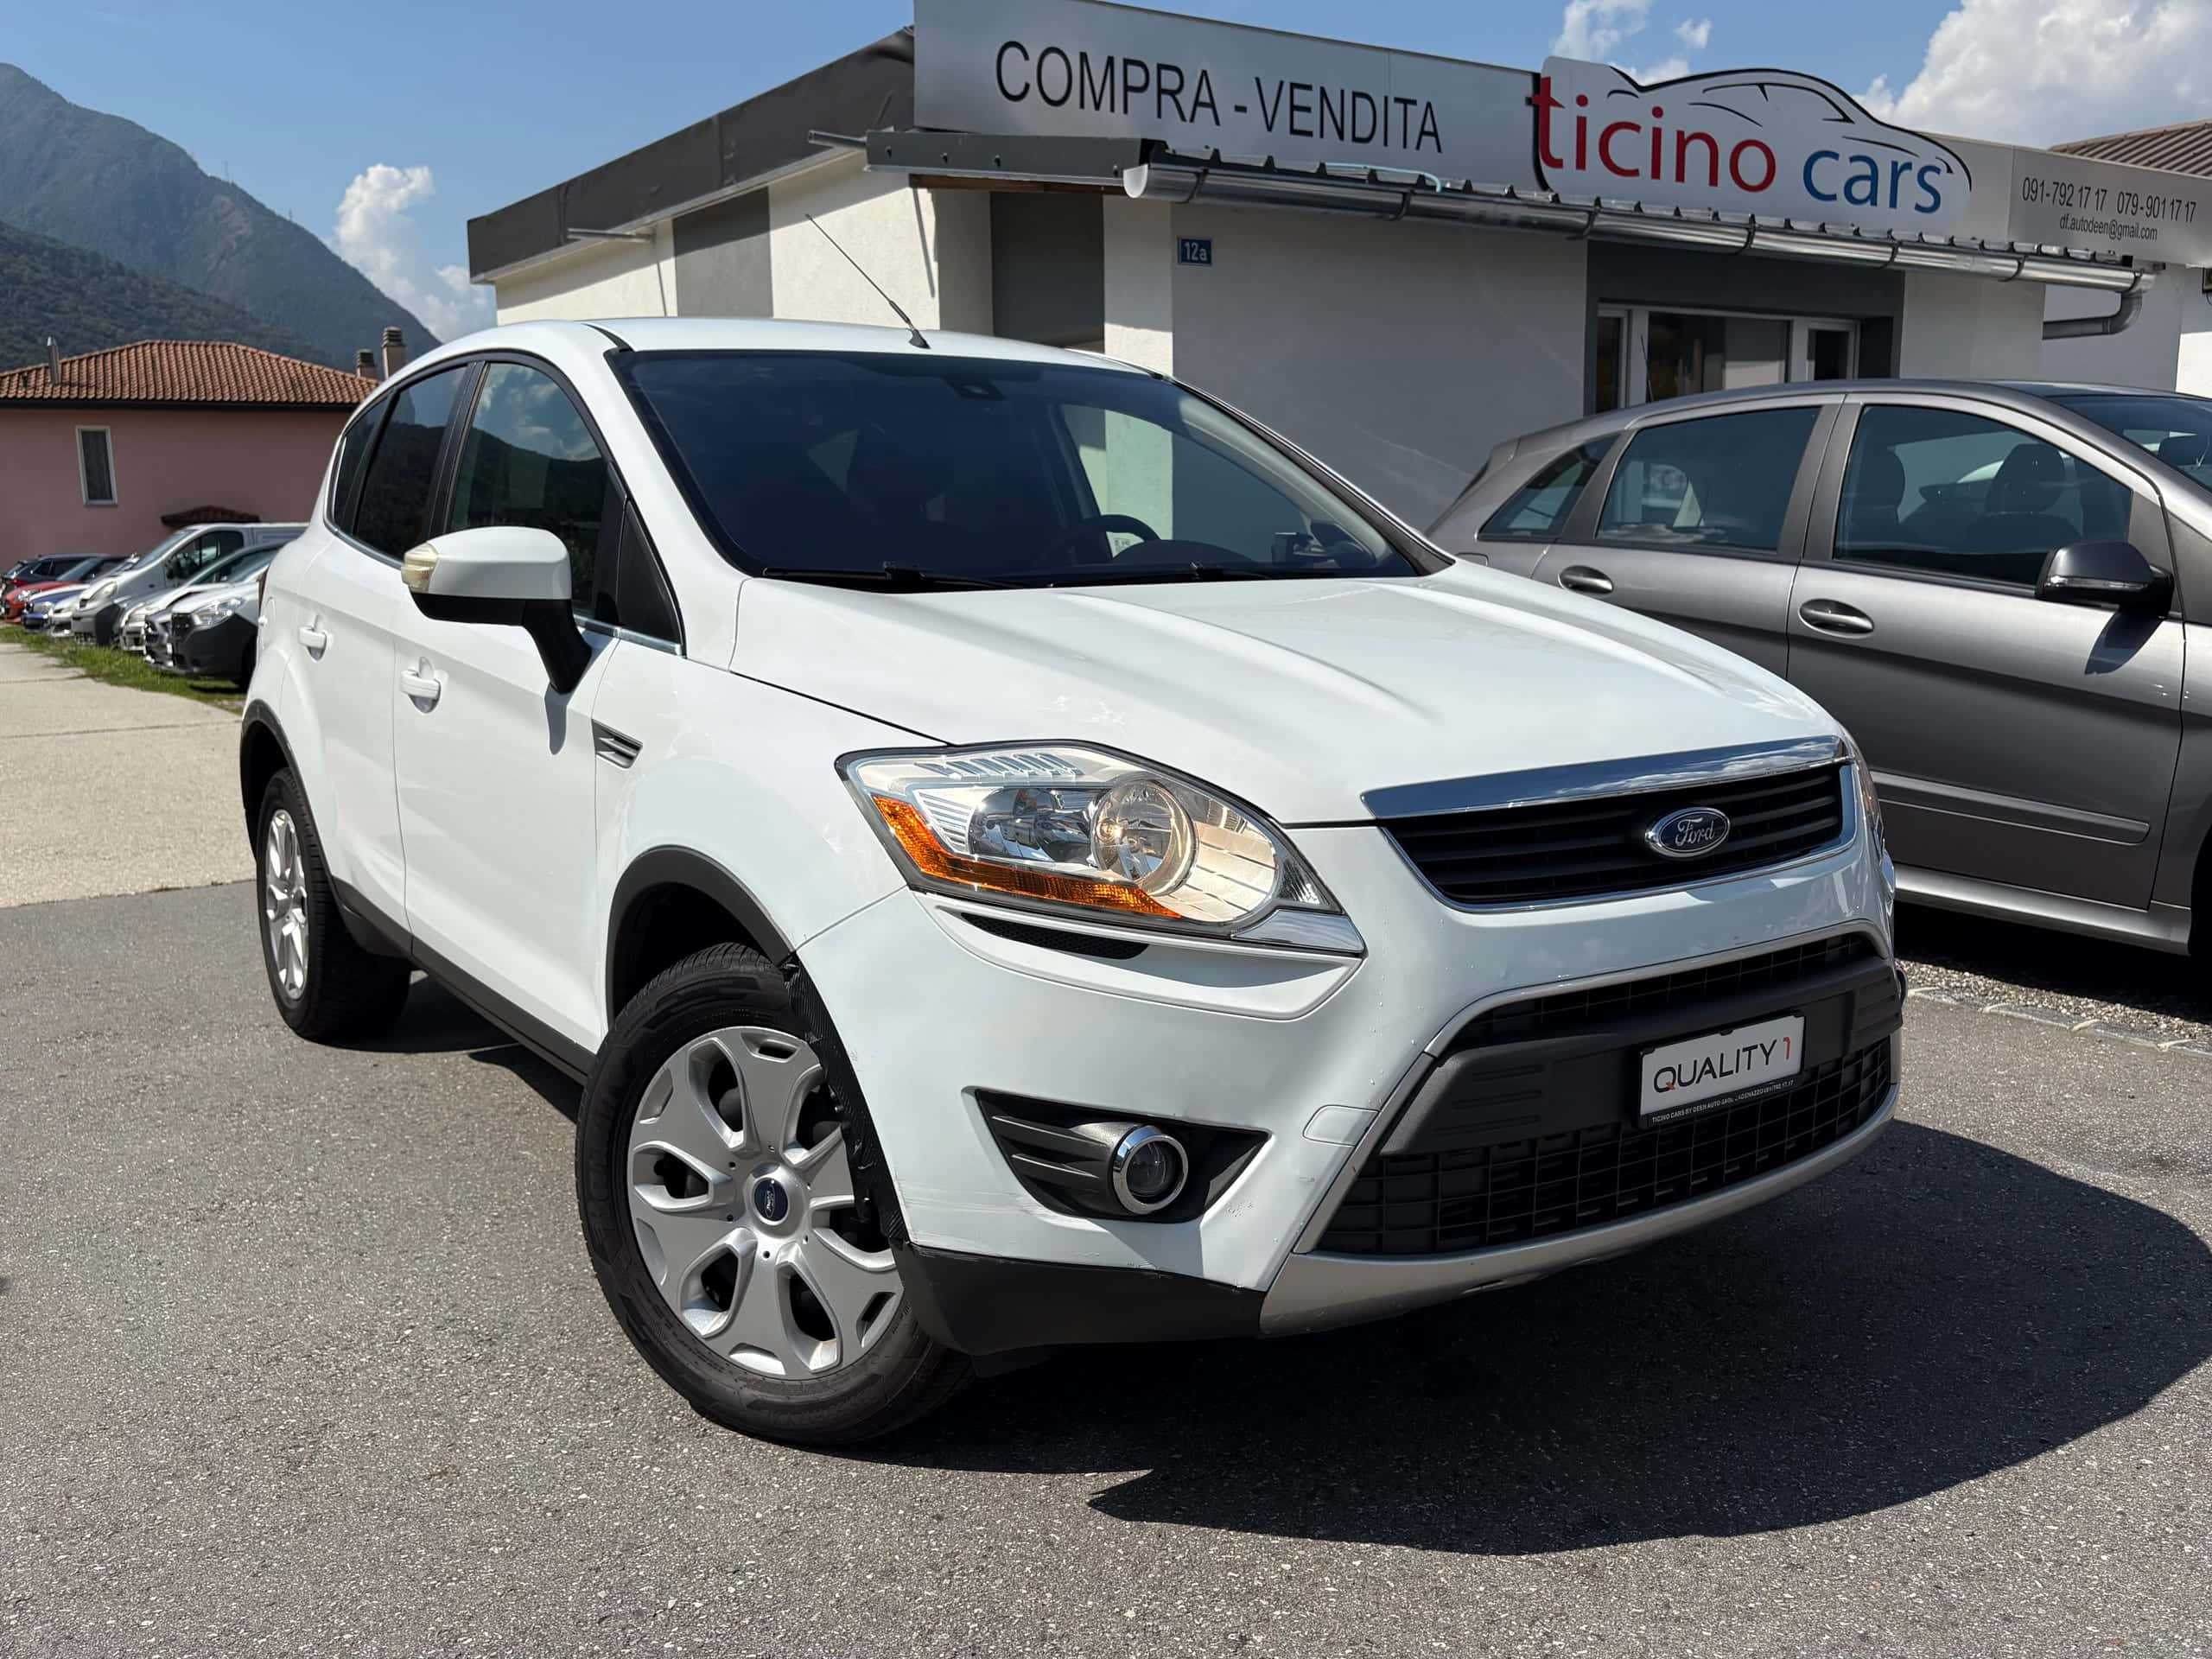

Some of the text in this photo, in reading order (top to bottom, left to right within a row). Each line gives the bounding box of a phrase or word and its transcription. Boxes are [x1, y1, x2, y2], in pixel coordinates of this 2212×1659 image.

[995, 41, 1220, 126] COMPRA
[1255, 77, 1442, 154] VENDITA
[1532, 76, 1942, 214] ticino cars
[2023, 176, 2197, 224] 091-792 17 17 079-901 17 17
[2060, 213, 2158, 241] df.autodeen@gmail.com
[1184, 241, 1207, 261] 12a
[1675, 817, 1715, 847] Ford
[1653, 1037, 1791, 1094] QUALITY 1
[1652, 1112, 1670, 1123] TICINO
[1670, 1109, 1685, 1120] CARS
[1707, 1100, 1721, 1109] AUTO
